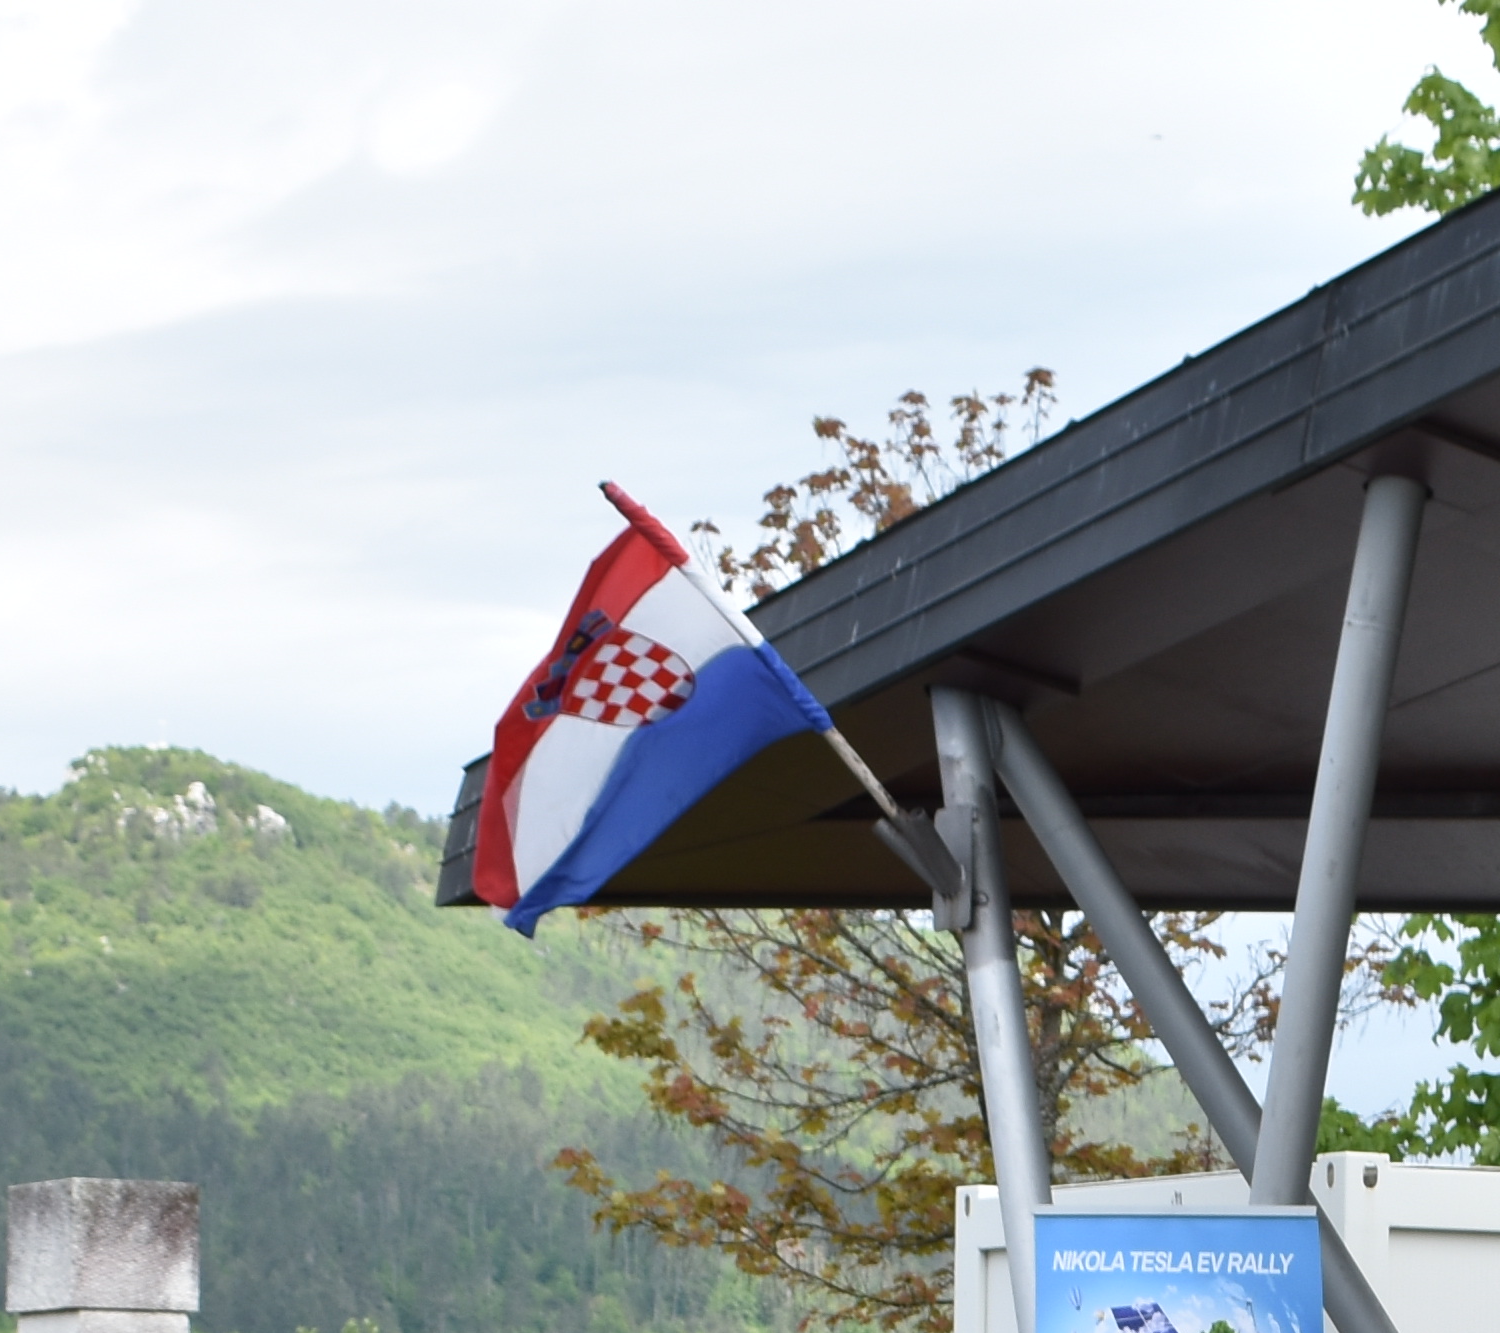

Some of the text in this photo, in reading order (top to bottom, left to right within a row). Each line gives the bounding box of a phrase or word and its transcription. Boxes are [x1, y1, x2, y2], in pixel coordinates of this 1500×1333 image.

[1052, 1250, 1294, 1275] NIKOLA TESLA EV RALLY
